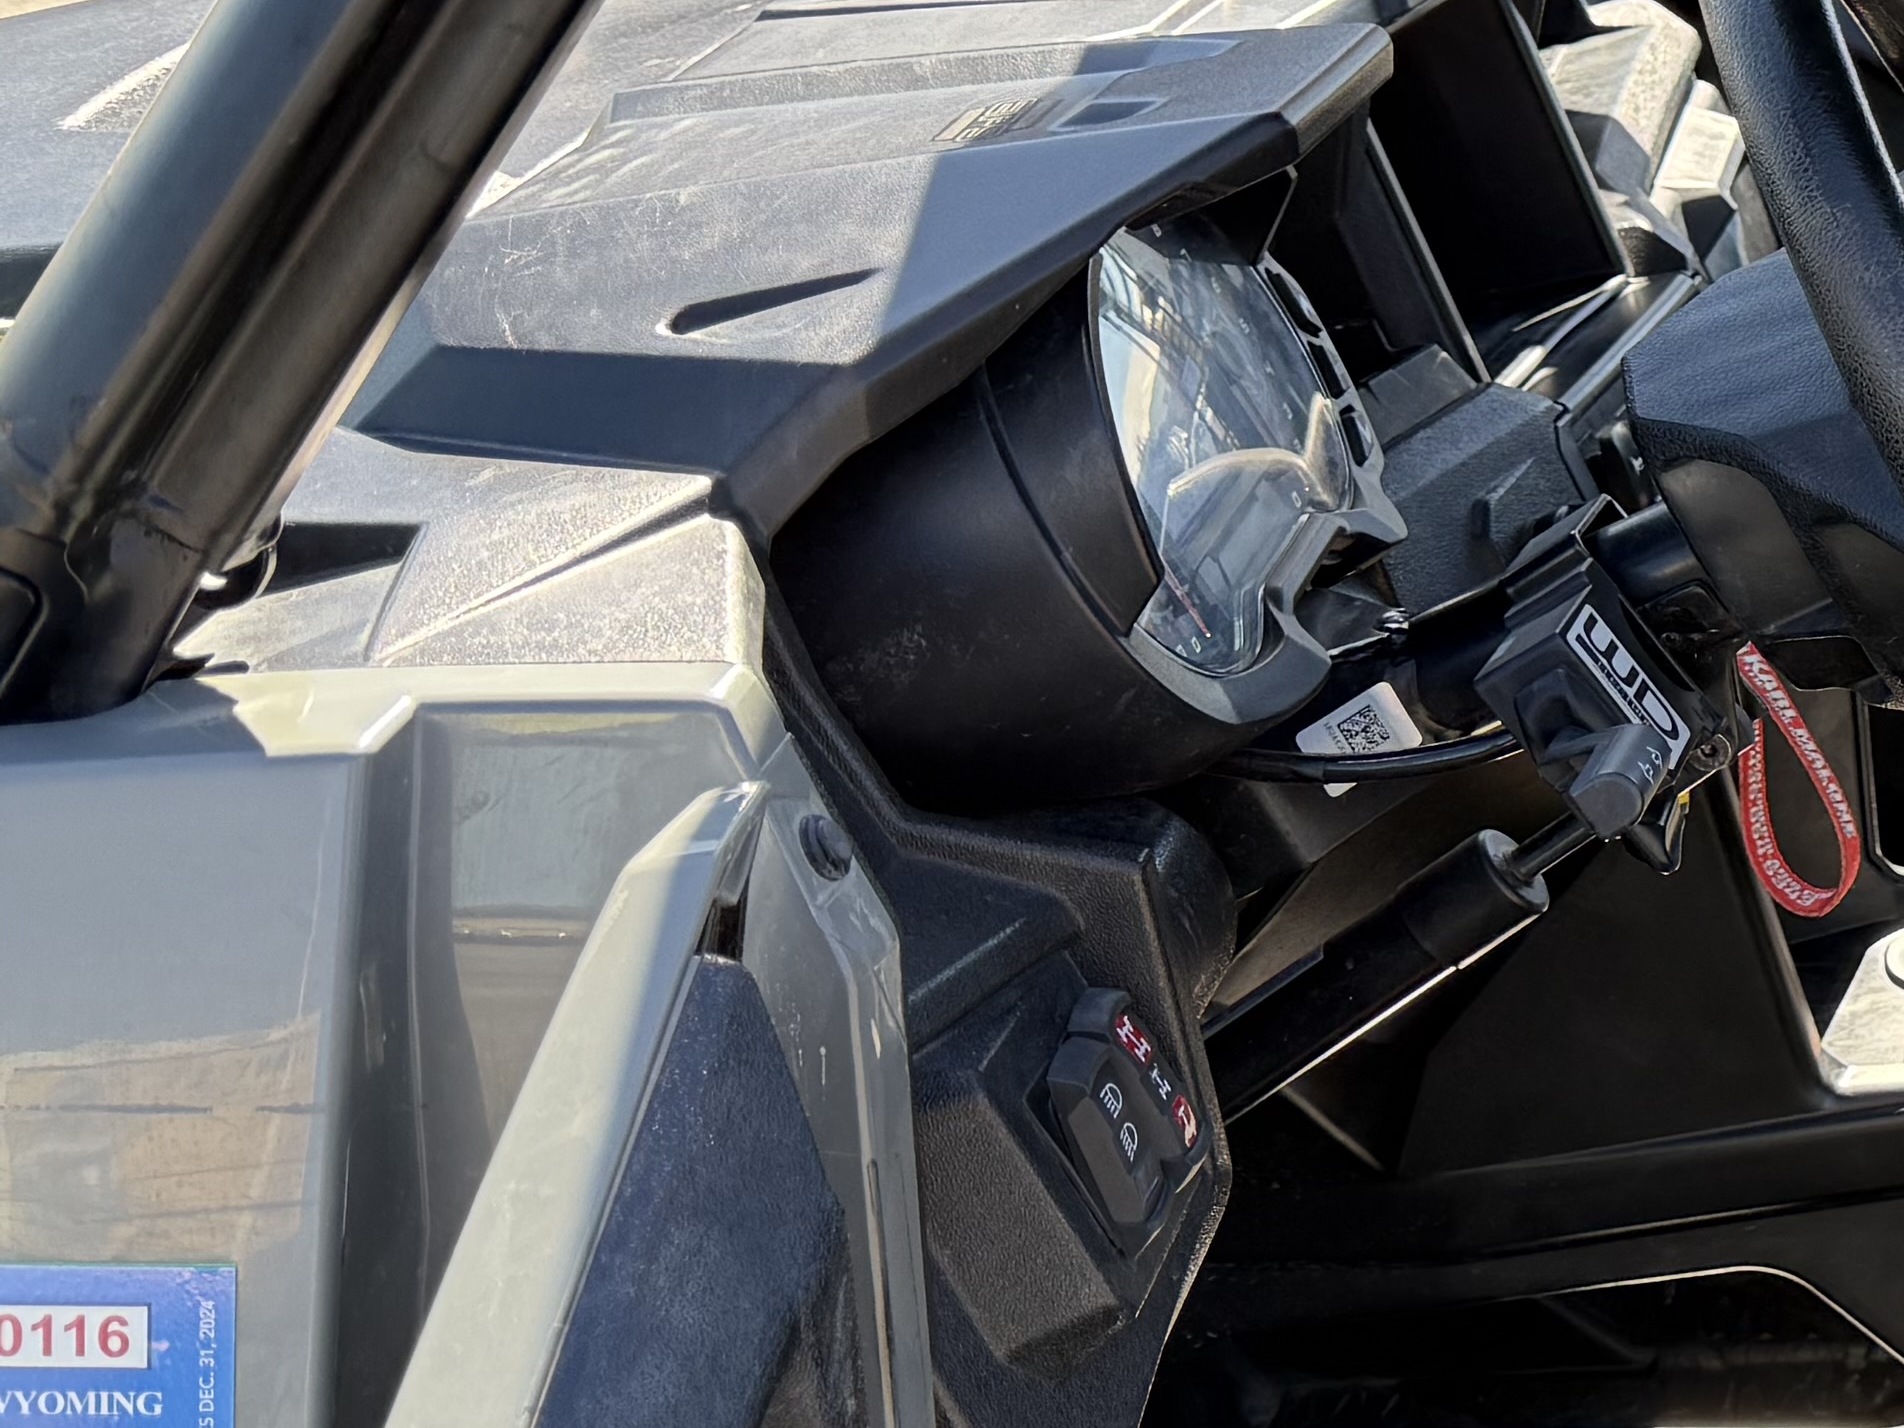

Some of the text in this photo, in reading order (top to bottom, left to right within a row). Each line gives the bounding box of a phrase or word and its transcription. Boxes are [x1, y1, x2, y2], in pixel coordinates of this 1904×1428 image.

[198, 1300, 216, 1339] 2024
[198, 1343, 217, 1367] 31,
[198, 1371, 215, 1413] DEC.
